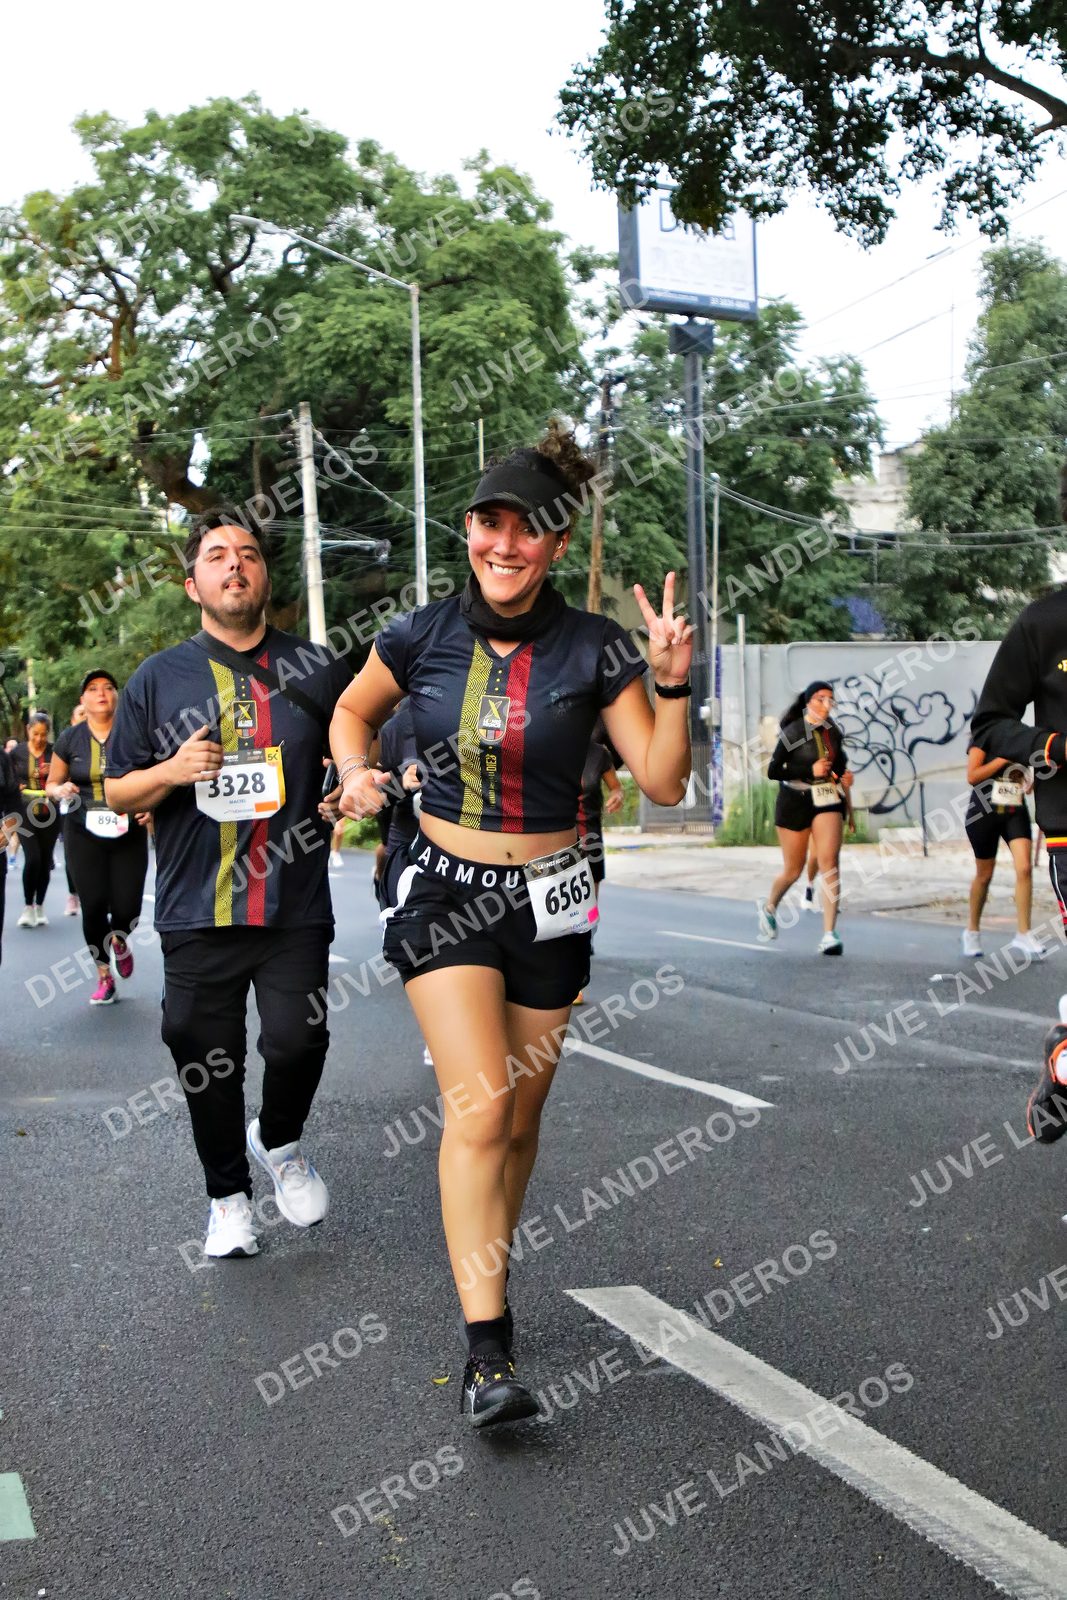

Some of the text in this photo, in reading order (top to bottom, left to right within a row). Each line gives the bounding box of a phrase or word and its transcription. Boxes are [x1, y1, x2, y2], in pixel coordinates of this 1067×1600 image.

[208, 772, 265, 798] 3328
[98, 815, 117, 826] 894
[545, 870, 590, 915] 6565
